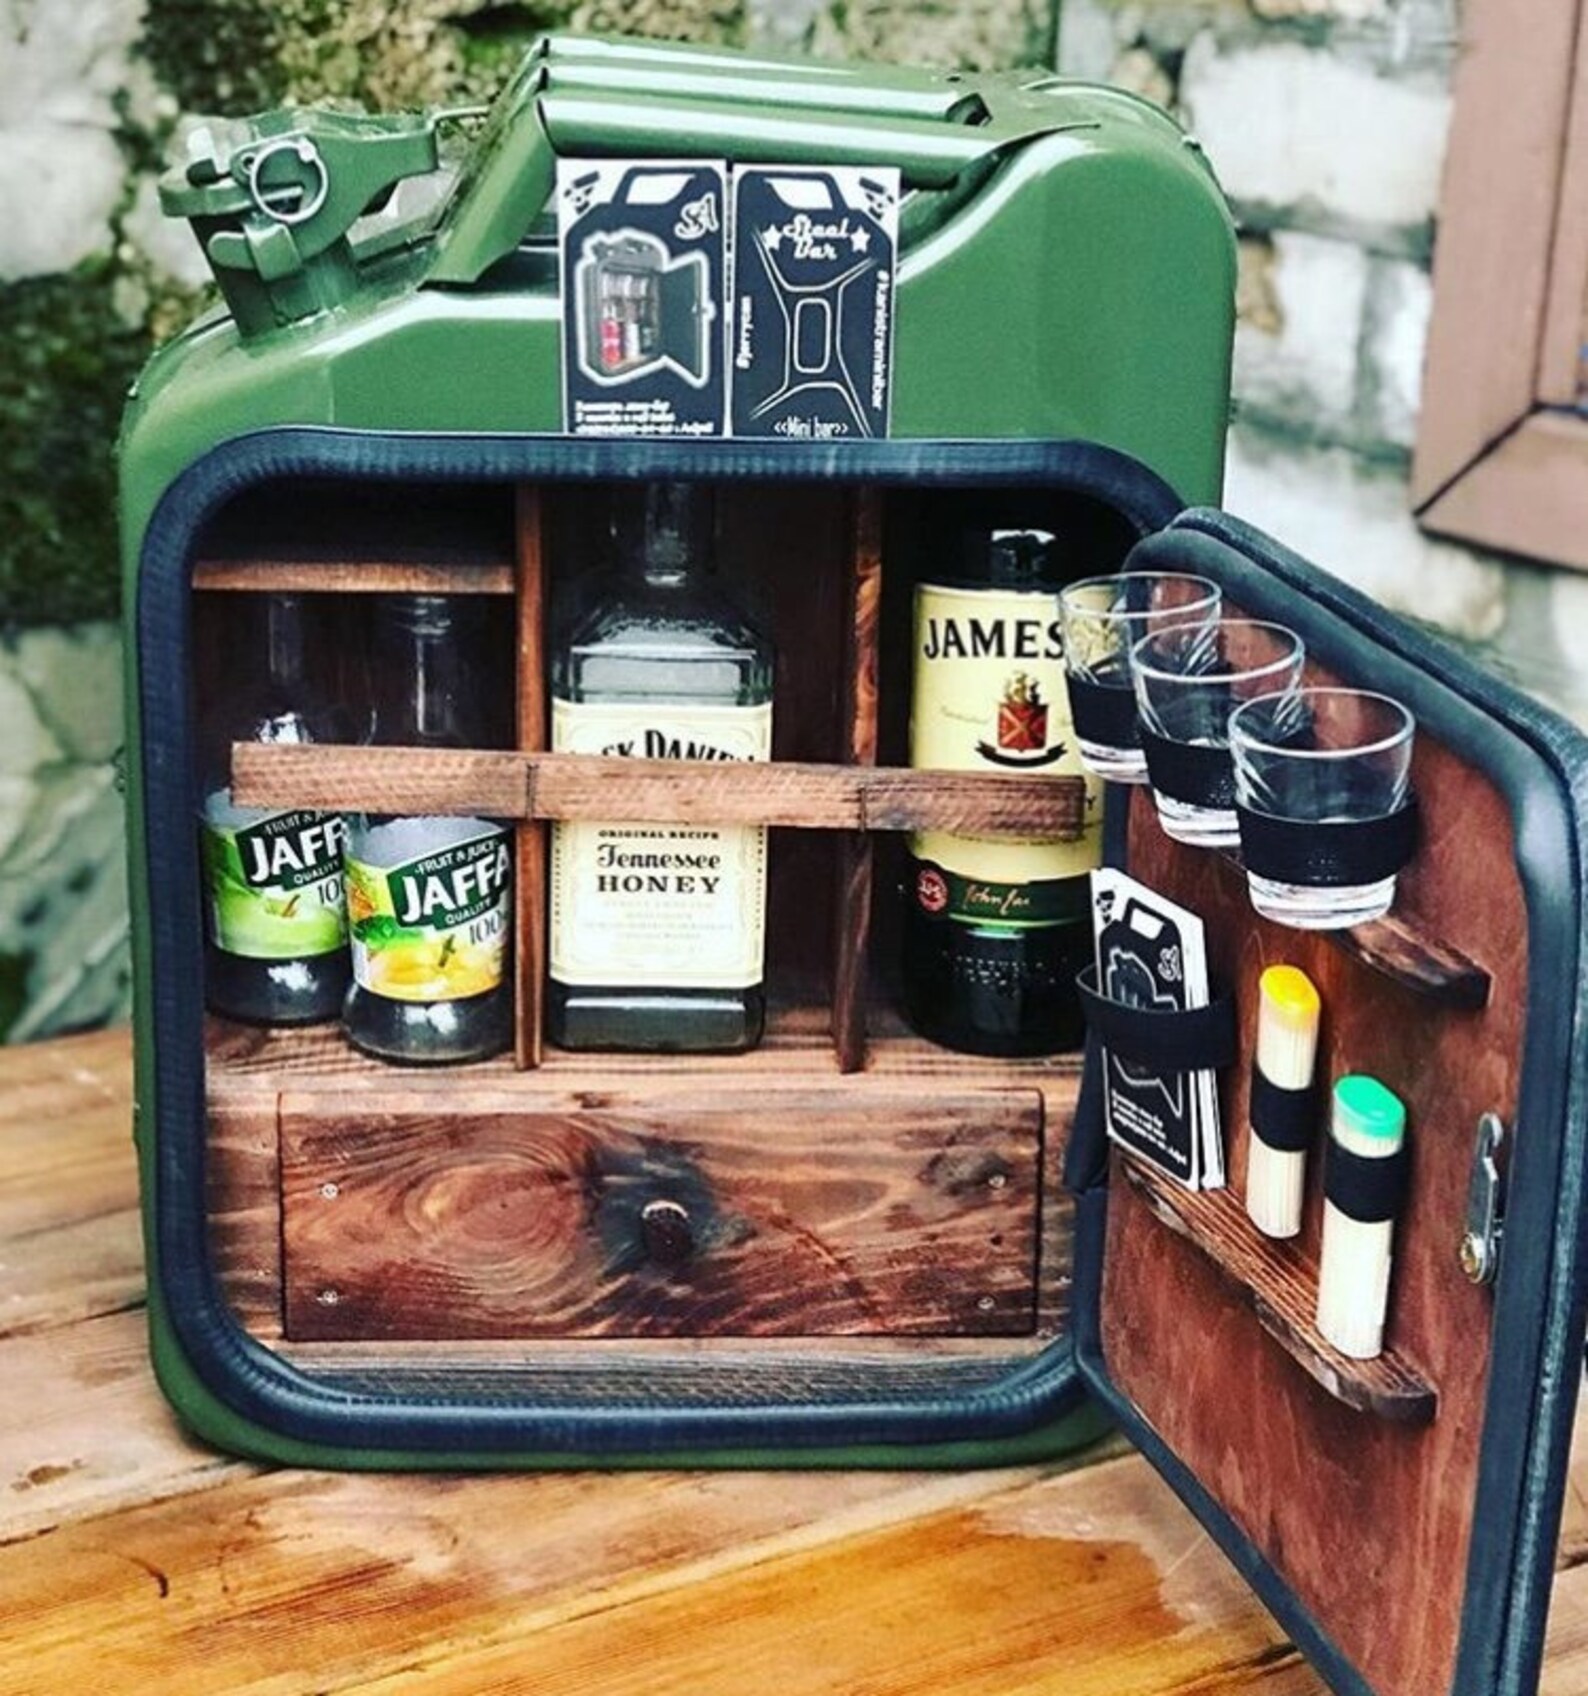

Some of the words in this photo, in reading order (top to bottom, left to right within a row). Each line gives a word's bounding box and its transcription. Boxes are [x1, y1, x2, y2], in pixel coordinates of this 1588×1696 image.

[924, 617, 1065, 660] JAMES
[598, 829, 665, 839] ORIGINAL
[669, 830, 720, 840] RECIPE
[250, 816, 346, 882] JAFF
[596, 843, 722, 870] Tennessee
[292, 858, 341, 884] QUALITY
[401, 843, 510, 924] JAFFA
[597, 874, 721, 894] HONEY
[444, 898, 492, 925] QUALITY
